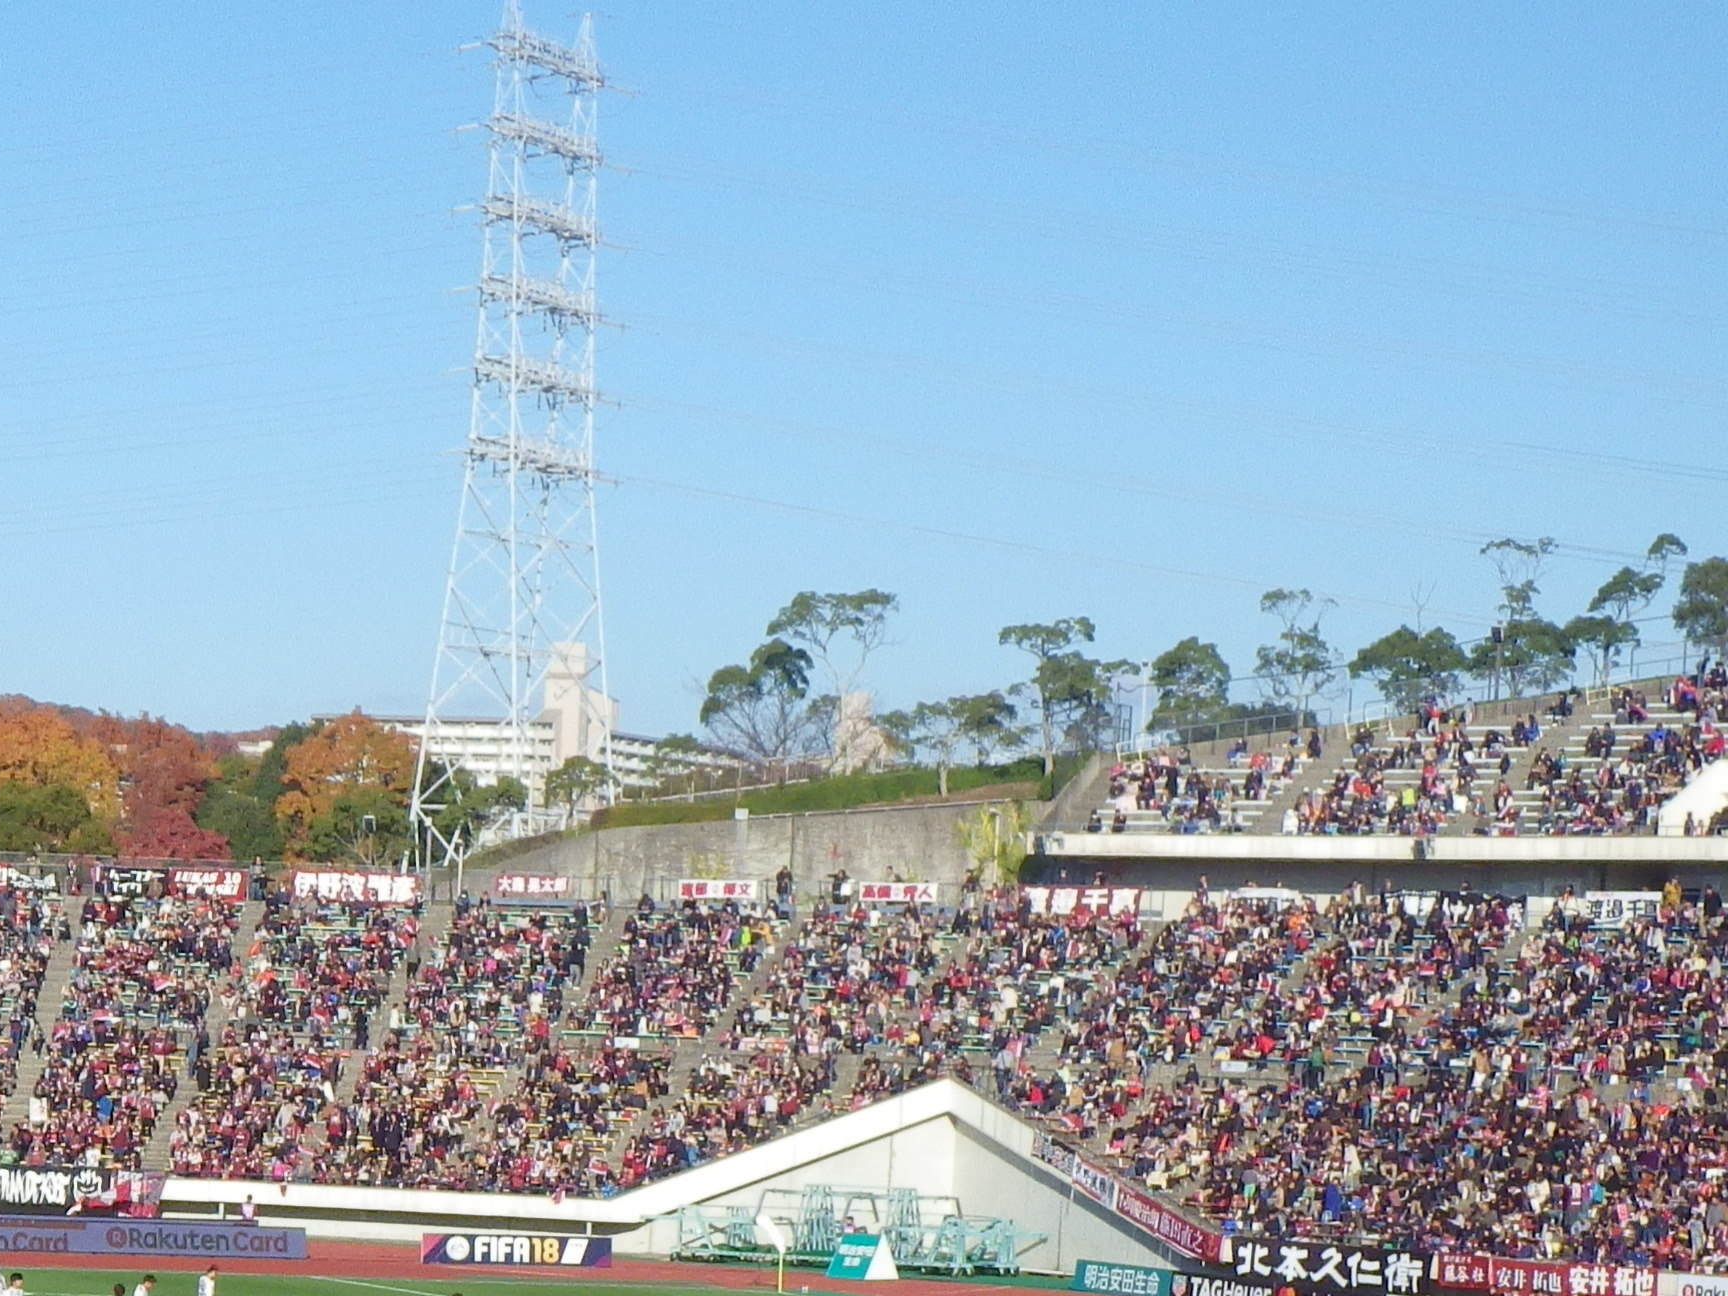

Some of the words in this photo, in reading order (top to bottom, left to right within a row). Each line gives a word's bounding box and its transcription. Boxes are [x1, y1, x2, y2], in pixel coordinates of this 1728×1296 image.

[12, 1231, 69, 1252] Card
[127, 1226, 230, 1251] Rakuten
[233, 1229, 289, 1253] Card
[1083, 1263, 1161, 1296] 明治安田生命
[1235, 1242, 1425, 1294] 北本久仁衛
